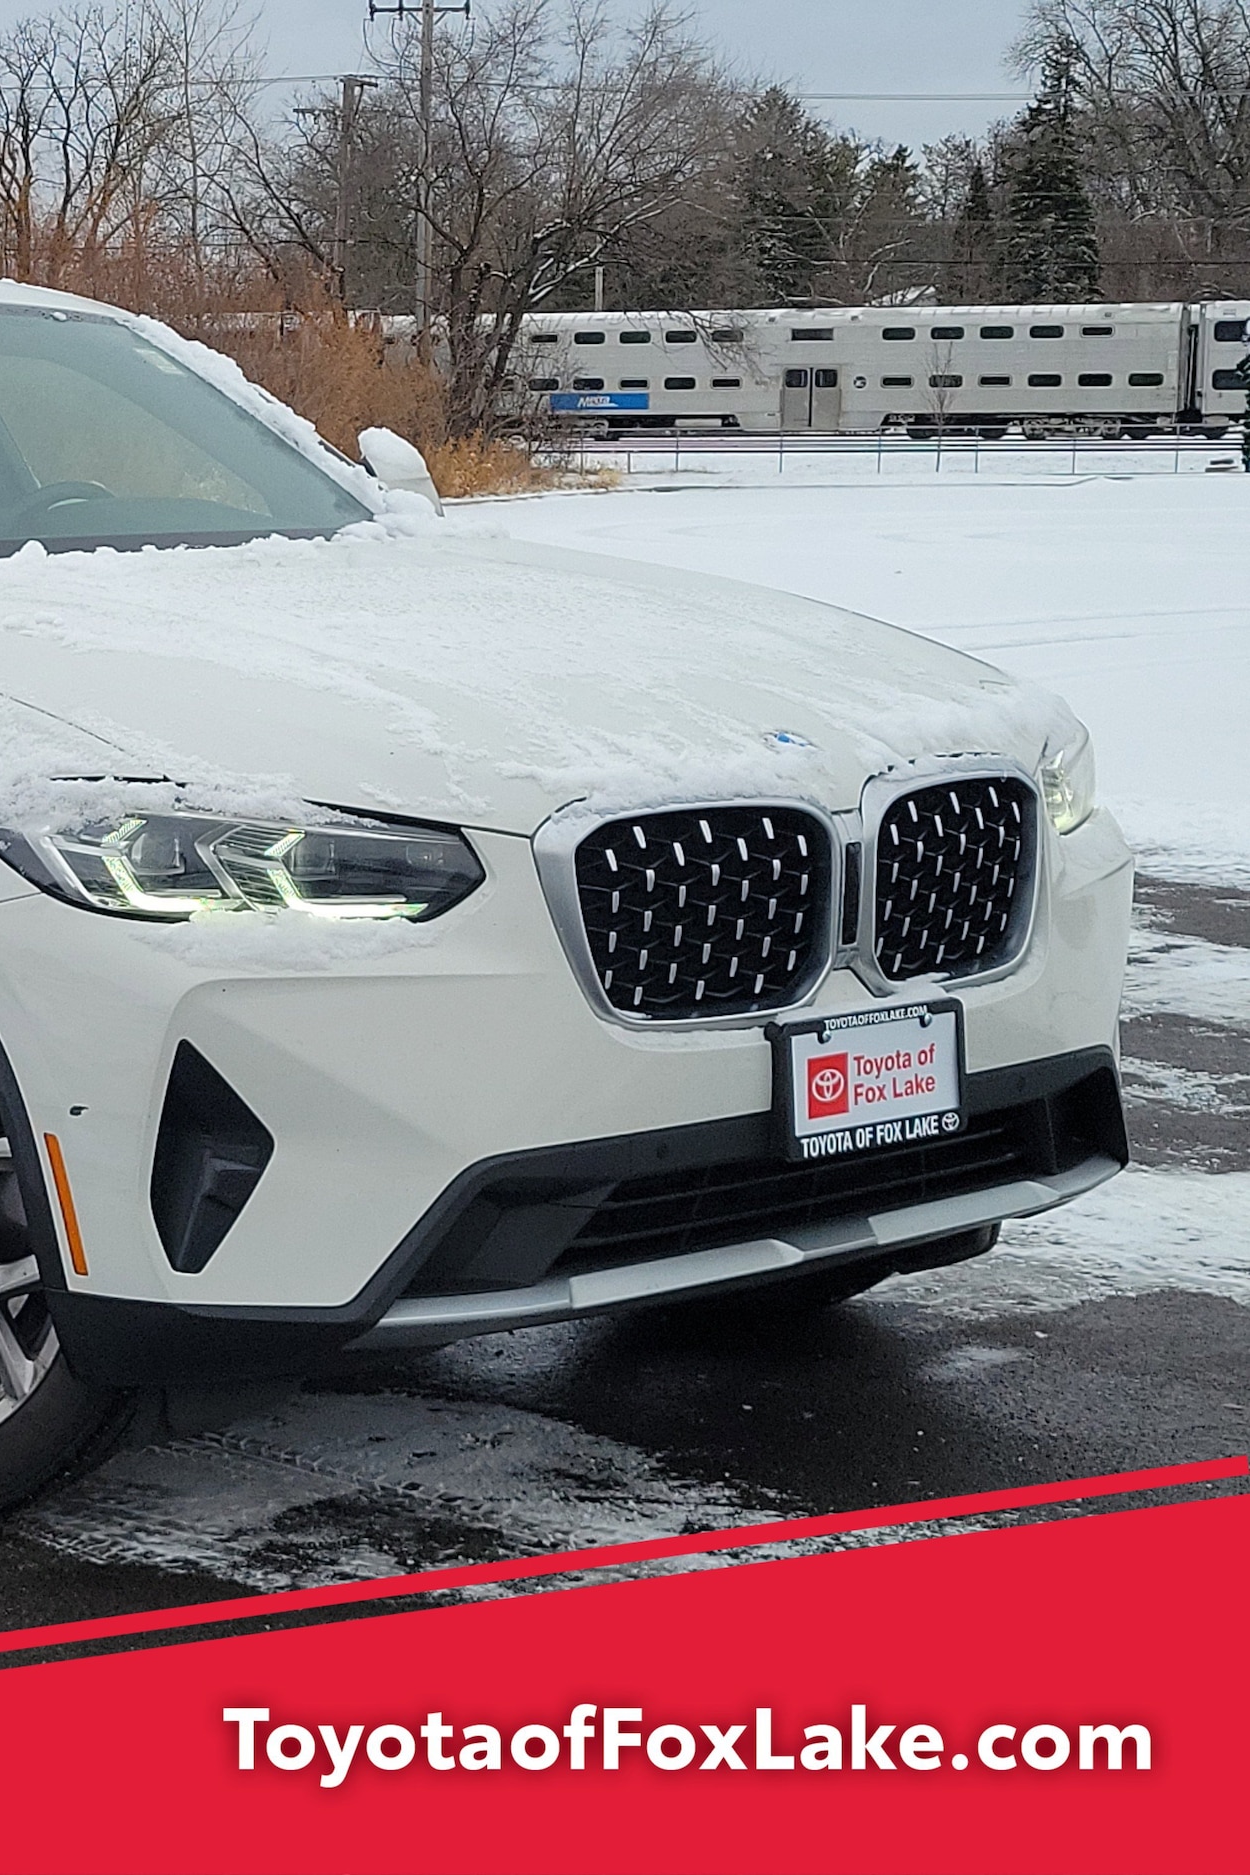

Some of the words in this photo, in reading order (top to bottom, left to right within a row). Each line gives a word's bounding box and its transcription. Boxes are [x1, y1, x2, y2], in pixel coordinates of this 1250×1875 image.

[824, 1005, 928, 1030] TOYOTAOFFOXLAKE.COM
[853, 1050, 912, 1079] Toyota
[917, 1043, 936, 1065] of
[853, 1081, 887, 1106] Fox
[892, 1073, 936, 1099] Lake
[801, 1131, 853, 1158] TOYOTA
[856, 1127, 874, 1149] OF
[876, 1121, 903, 1146] FOX
[905, 1115, 939, 1139] LAKE
